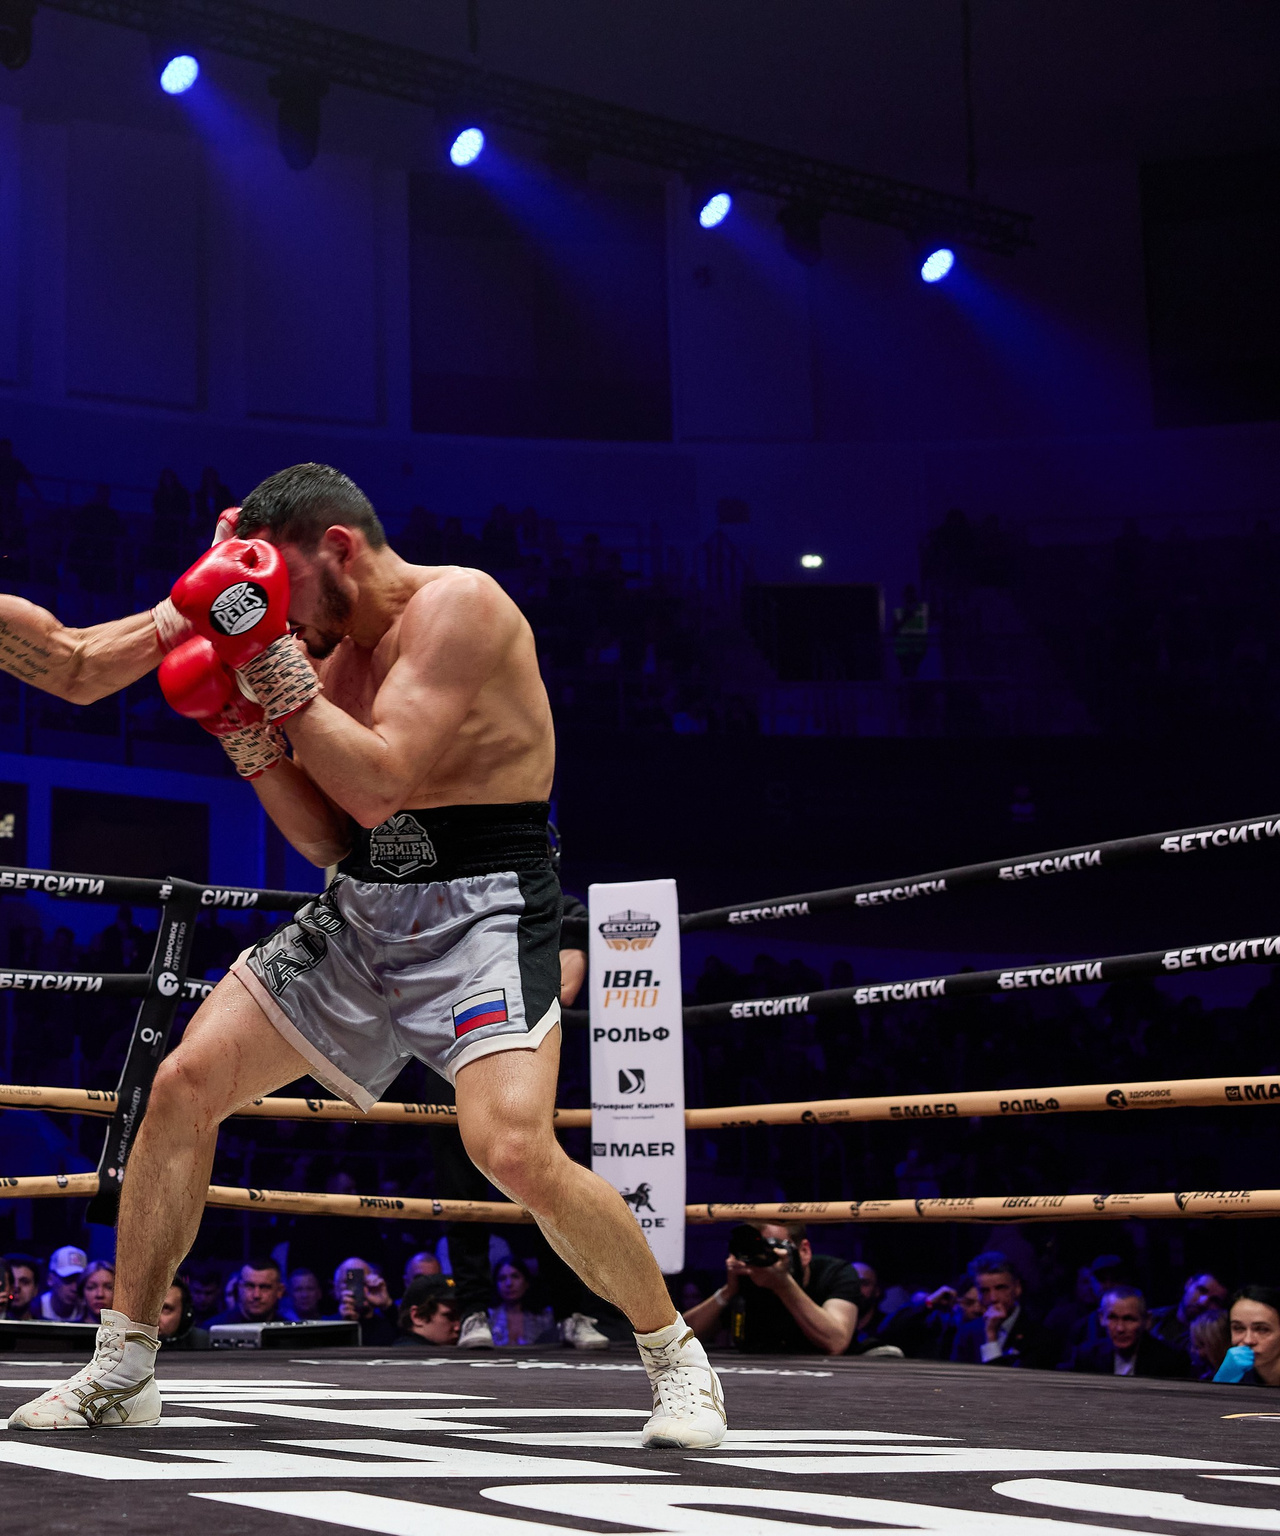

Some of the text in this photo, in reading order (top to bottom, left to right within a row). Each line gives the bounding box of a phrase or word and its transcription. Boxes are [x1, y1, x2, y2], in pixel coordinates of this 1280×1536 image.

[214, 588, 263, 633] REYES
[1160, 821, 1280, 853] БЕТСИТИ
[372, 842, 433, 860] PREMIER
[998, 850, 1102, 880] БЕТСИТИ
[854, 879, 947, 907] БЕТСИТИ
[728, 902, 810, 925] БЕТСИТИ
[163, 921, 179, 968] ЗДОРОВОЕ
[172, 922, 187, 971] ОТЕЧЕСТВО
[1161, 937, 1280, 970] БЕТСИТИ
[603, 970, 661, 988] IBA.
[997, 961, 1103, 989] БЕТСИТИ
[604, 989, 659, 1008] PRO
[853, 979, 946, 1005] БЕТСИТИ
[730, 996, 810, 1019] БЕТСИТИ
[593, 1027, 670, 1042] РОЛЬФ
[418, 1103, 457, 1115] MAE
[592, 1102, 675, 1110] Бумеранг Капитал
[999, 1098, 1060, 1113] РОЛЬФ
[610, 1142, 675, 1157] MAER
